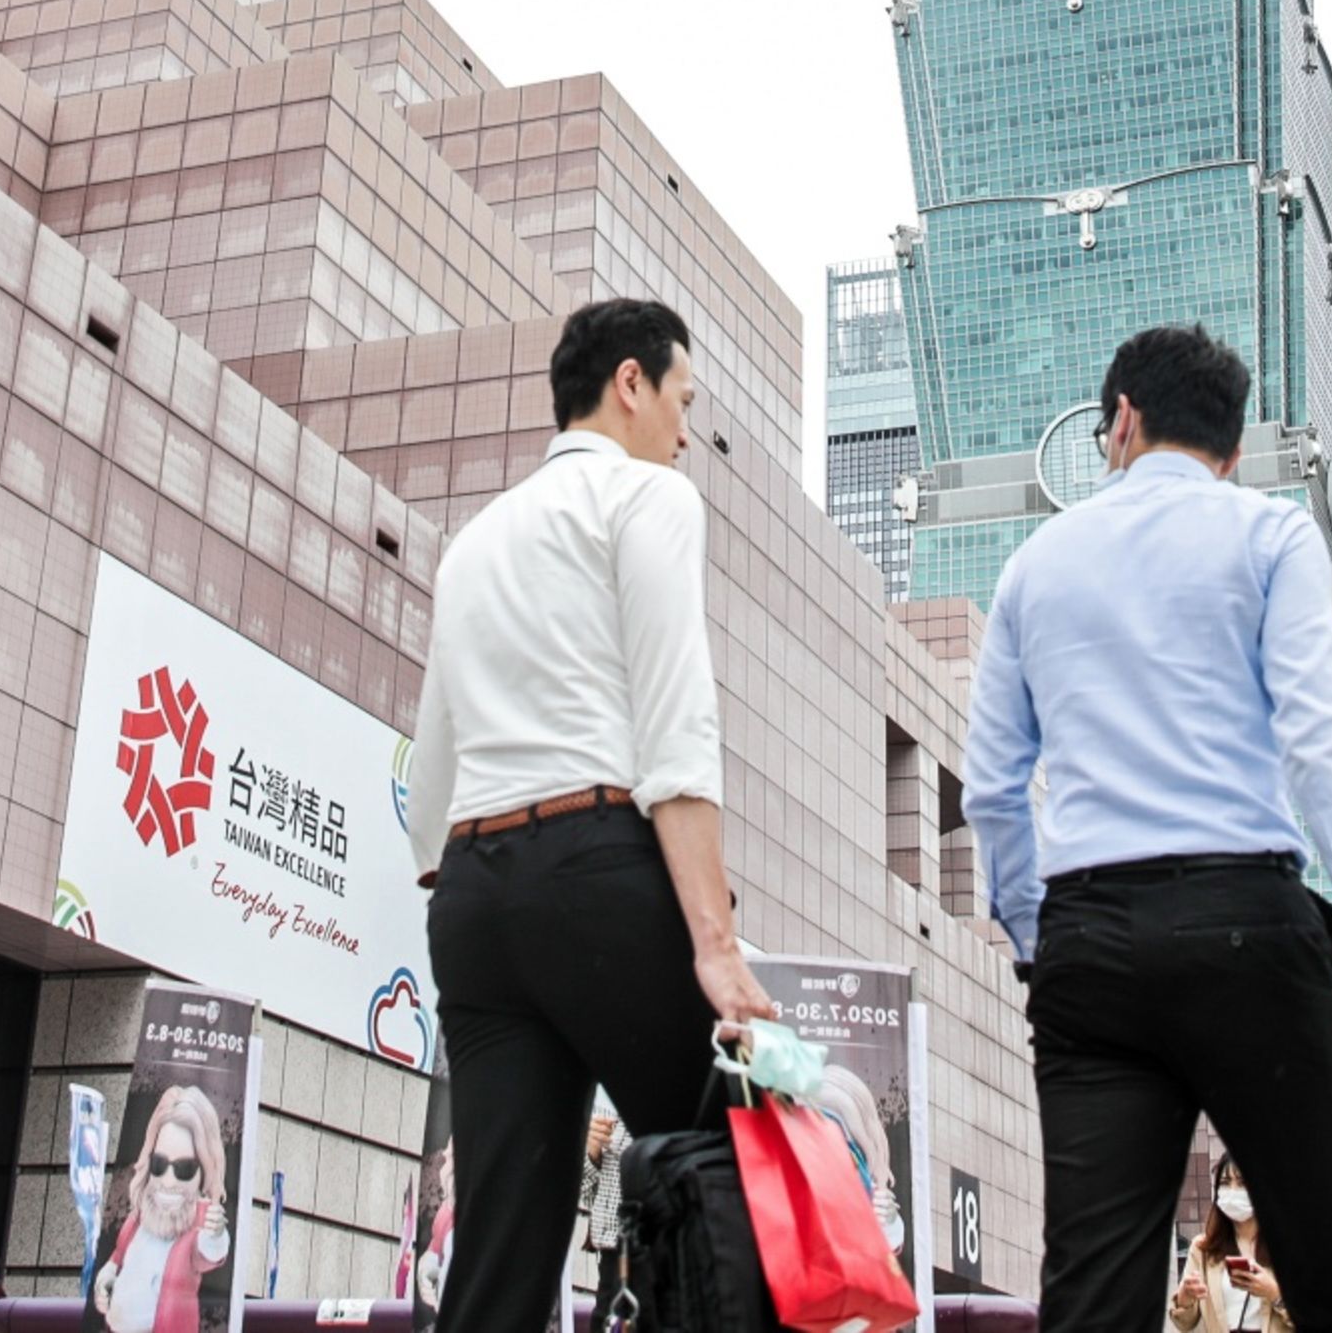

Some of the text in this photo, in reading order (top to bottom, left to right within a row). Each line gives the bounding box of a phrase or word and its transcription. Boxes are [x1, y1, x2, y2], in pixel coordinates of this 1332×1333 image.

[228, 747, 348, 863] 台灣精品
[224, 818, 347, 898] TAIWAN EXCELLENCE
[211, 862, 360, 956] Everyday Excellence
[953, 1185, 980, 1265] 18
